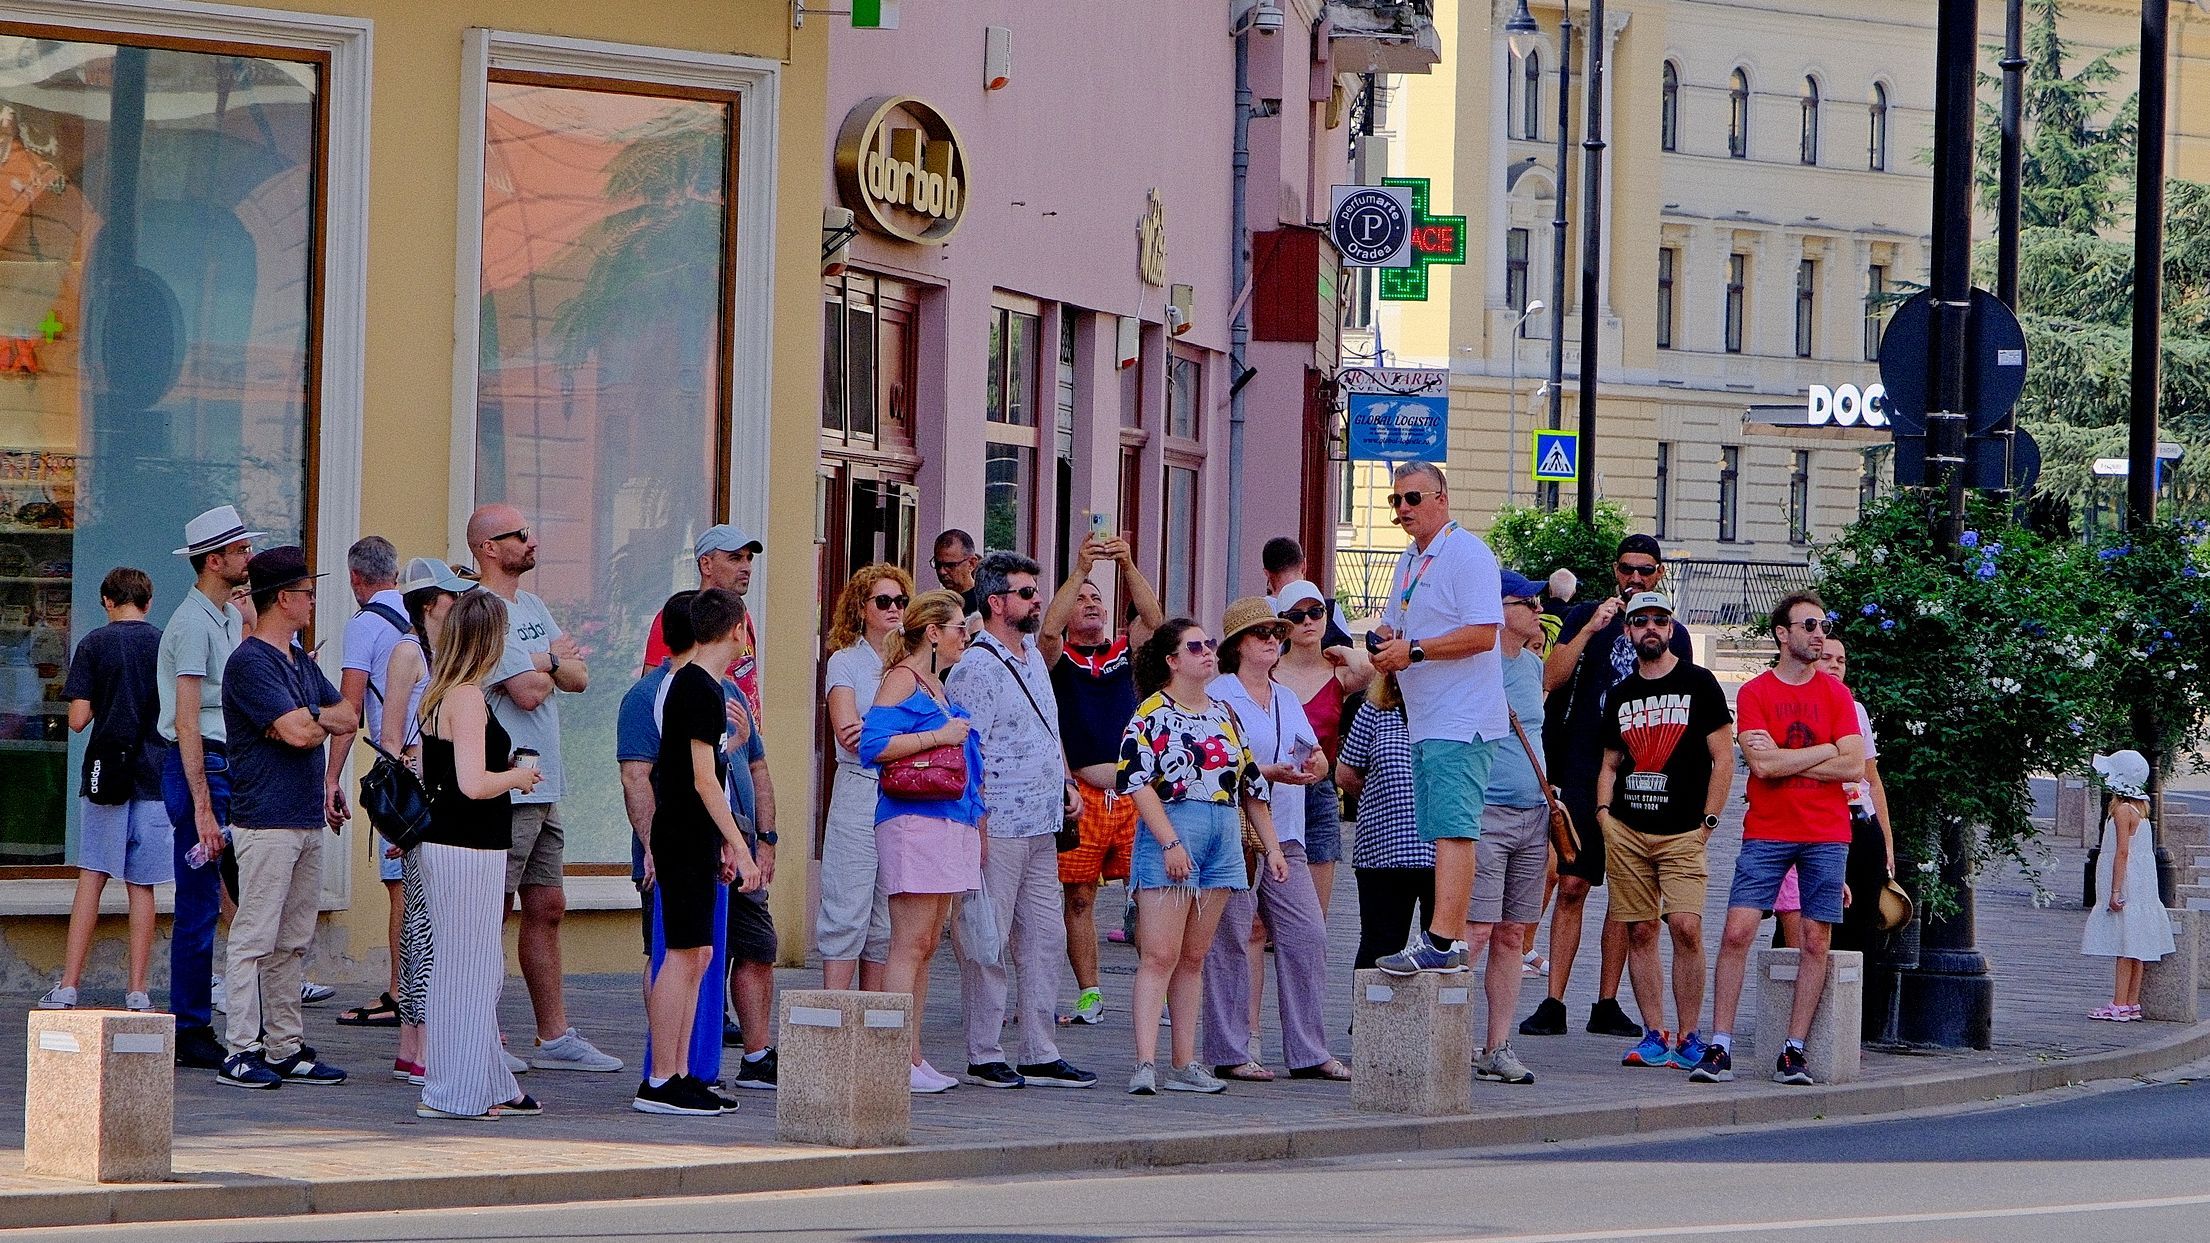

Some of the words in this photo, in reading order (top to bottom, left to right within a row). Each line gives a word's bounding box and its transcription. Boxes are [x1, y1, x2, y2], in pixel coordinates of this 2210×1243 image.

[868, 120, 959, 220] dorbob
[1341, 195, 1400, 220] perfumarte
[1361, 214, 1383, 241] P
[1347, 242, 1393, 259] Oradea
[1808, 383, 1891, 427] DOC
[1354, 415, 1392, 426] GLOBAL
[1394, 415, 1441, 427] LOGISTIC
[1618, 708, 1690, 733] STEIN
[91, 759, 101, 794] adidas
[1643, 803, 1659, 811] 2024
